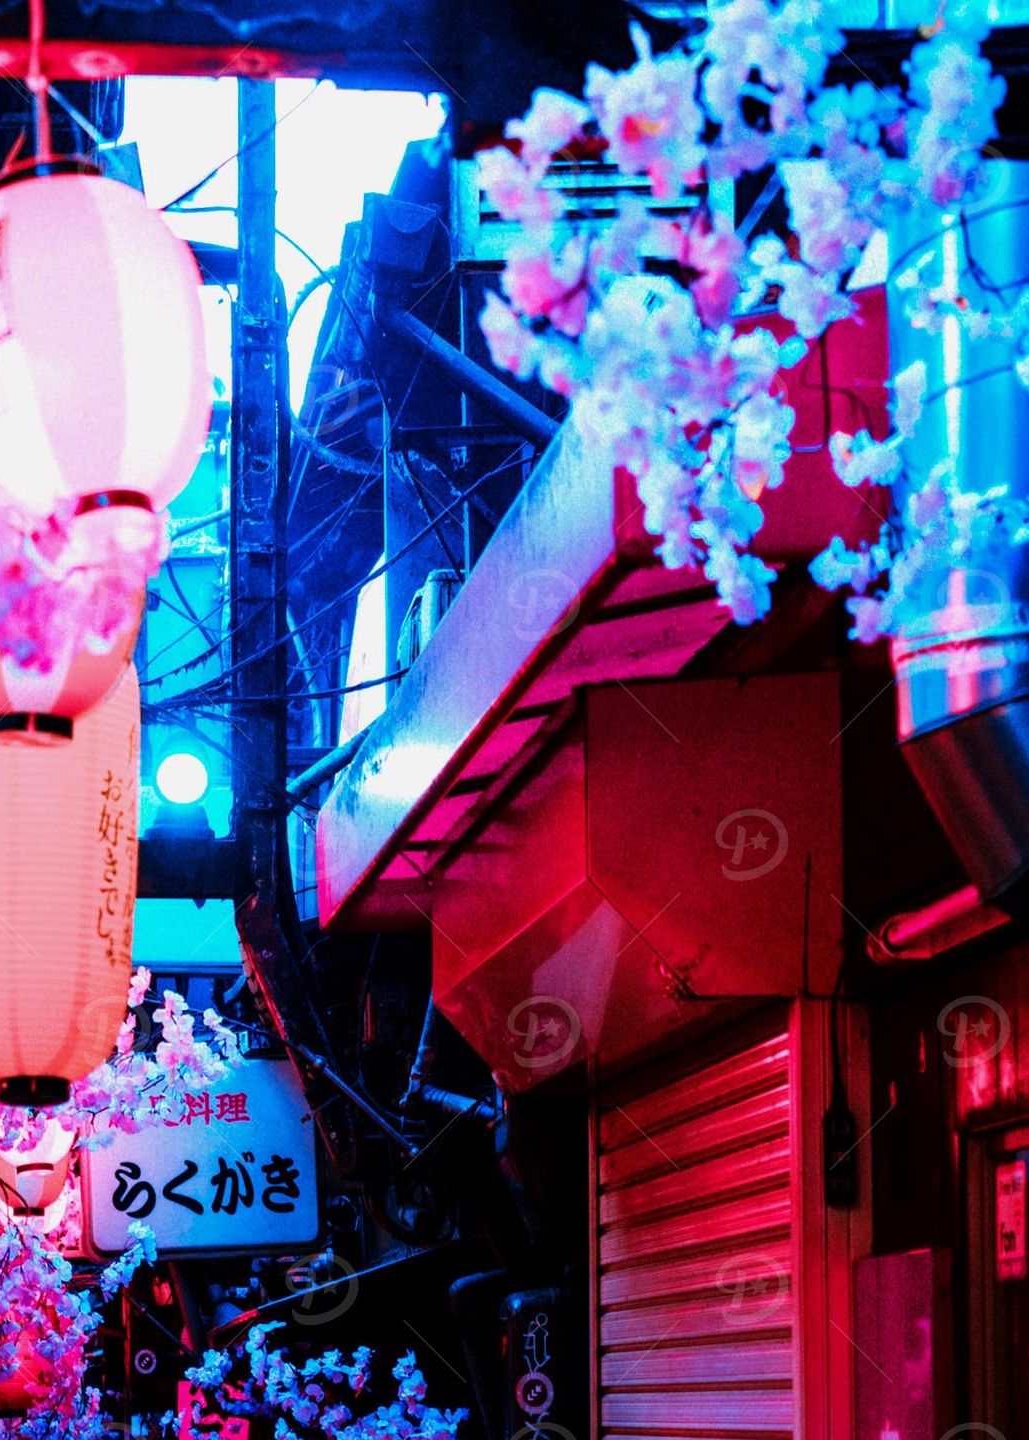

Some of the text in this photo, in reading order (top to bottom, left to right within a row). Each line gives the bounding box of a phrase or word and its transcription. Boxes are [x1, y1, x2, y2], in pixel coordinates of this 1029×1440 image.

[150, 1091, 251, 1127] 料理
[112, 1151, 301, 1219] らくがき
